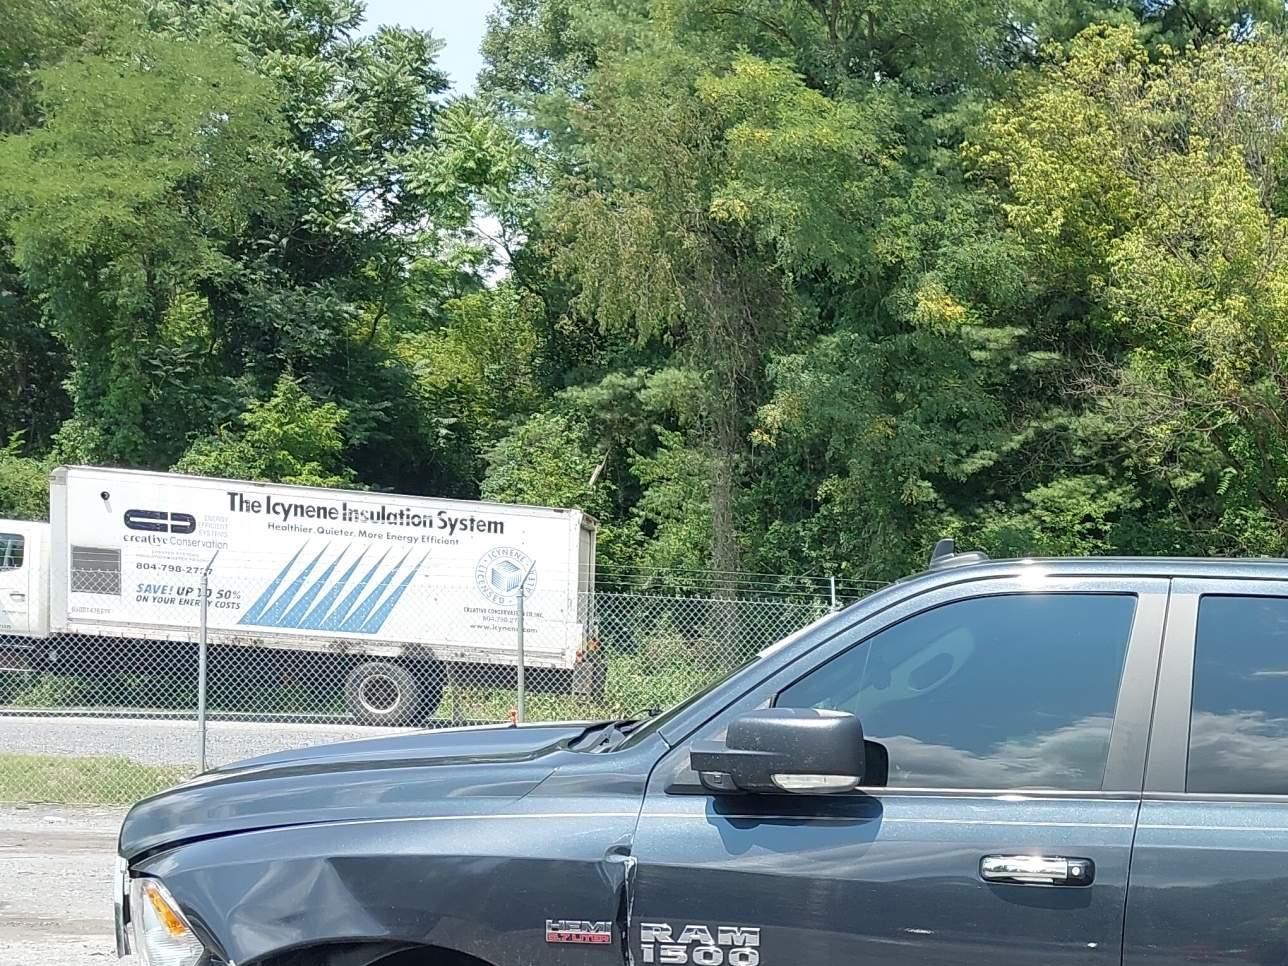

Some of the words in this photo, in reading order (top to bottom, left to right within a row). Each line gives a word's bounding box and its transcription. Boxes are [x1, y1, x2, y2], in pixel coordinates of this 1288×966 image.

[227, 491, 262, 514] The
[265, 495, 340, 522] Icynene
[342, 501, 434, 529] Insulation
[436, 510, 505, 536] System
[123, 534, 168, 547] creative
[169, 536, 229, 550] Conservation
[358, 530, 383, 540] More
[386, 531, 419, 545] Energy
[421, 535, 459, 546] Efficient
[136, 583, 174, 595] SAVE!
[176, 586, 194, 598] UP
[215, 589, 241, 600] 50%
[135, 595, 149, 603] ON
[152, 596, 176, 605] YOUR
[178, 599, 213, 608] ENERY
[214, 600, 241, 610] COSTS
[546, 920, 612, 934] HEMI
[640, 922, 761, 946] RAM
